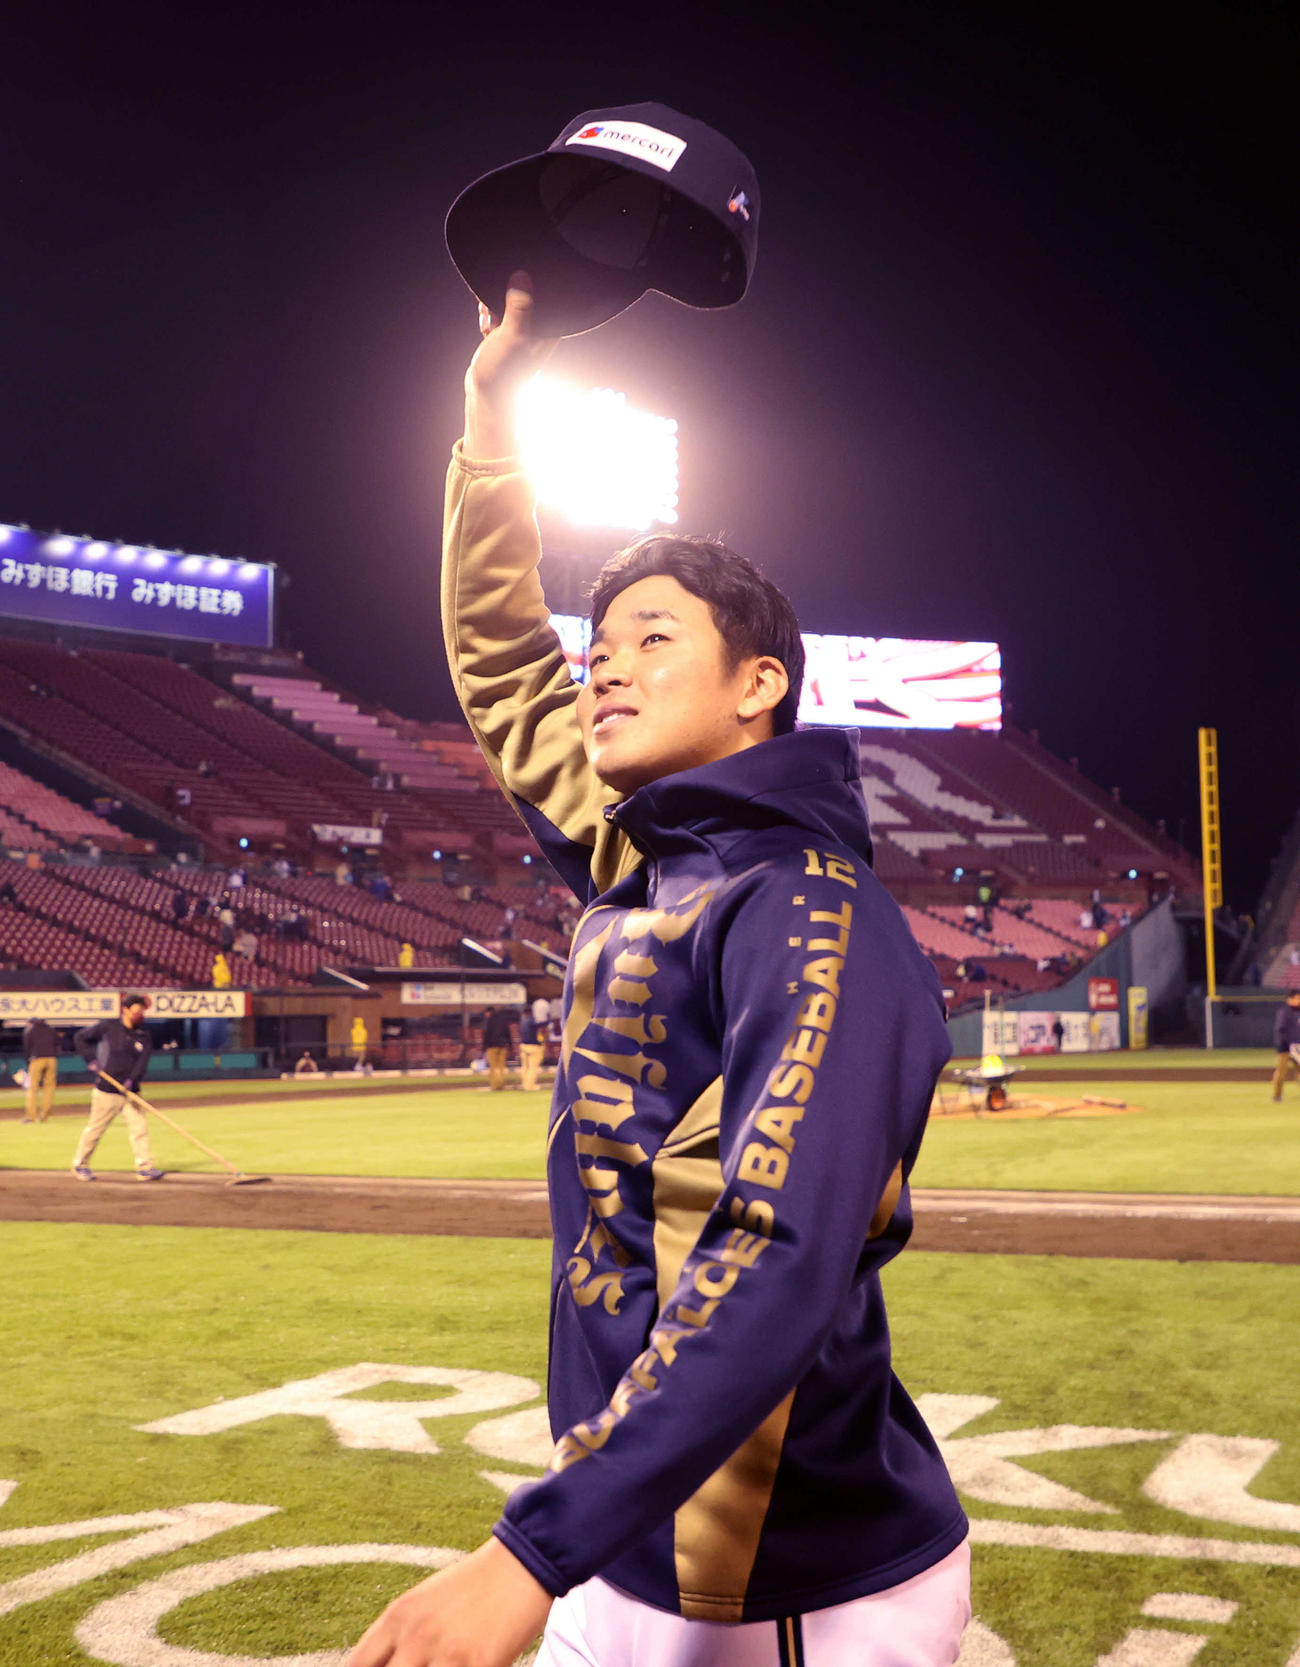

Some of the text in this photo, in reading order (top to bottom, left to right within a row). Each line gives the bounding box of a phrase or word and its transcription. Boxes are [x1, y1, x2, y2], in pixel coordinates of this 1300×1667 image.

[603, 130, 675, 159] mercari
[1, 558, 244, 617] みずほ銀行 みずほ証券
[803, 848, 858, 889] 12
[736, 900, 853, 1191] BASEBALL
